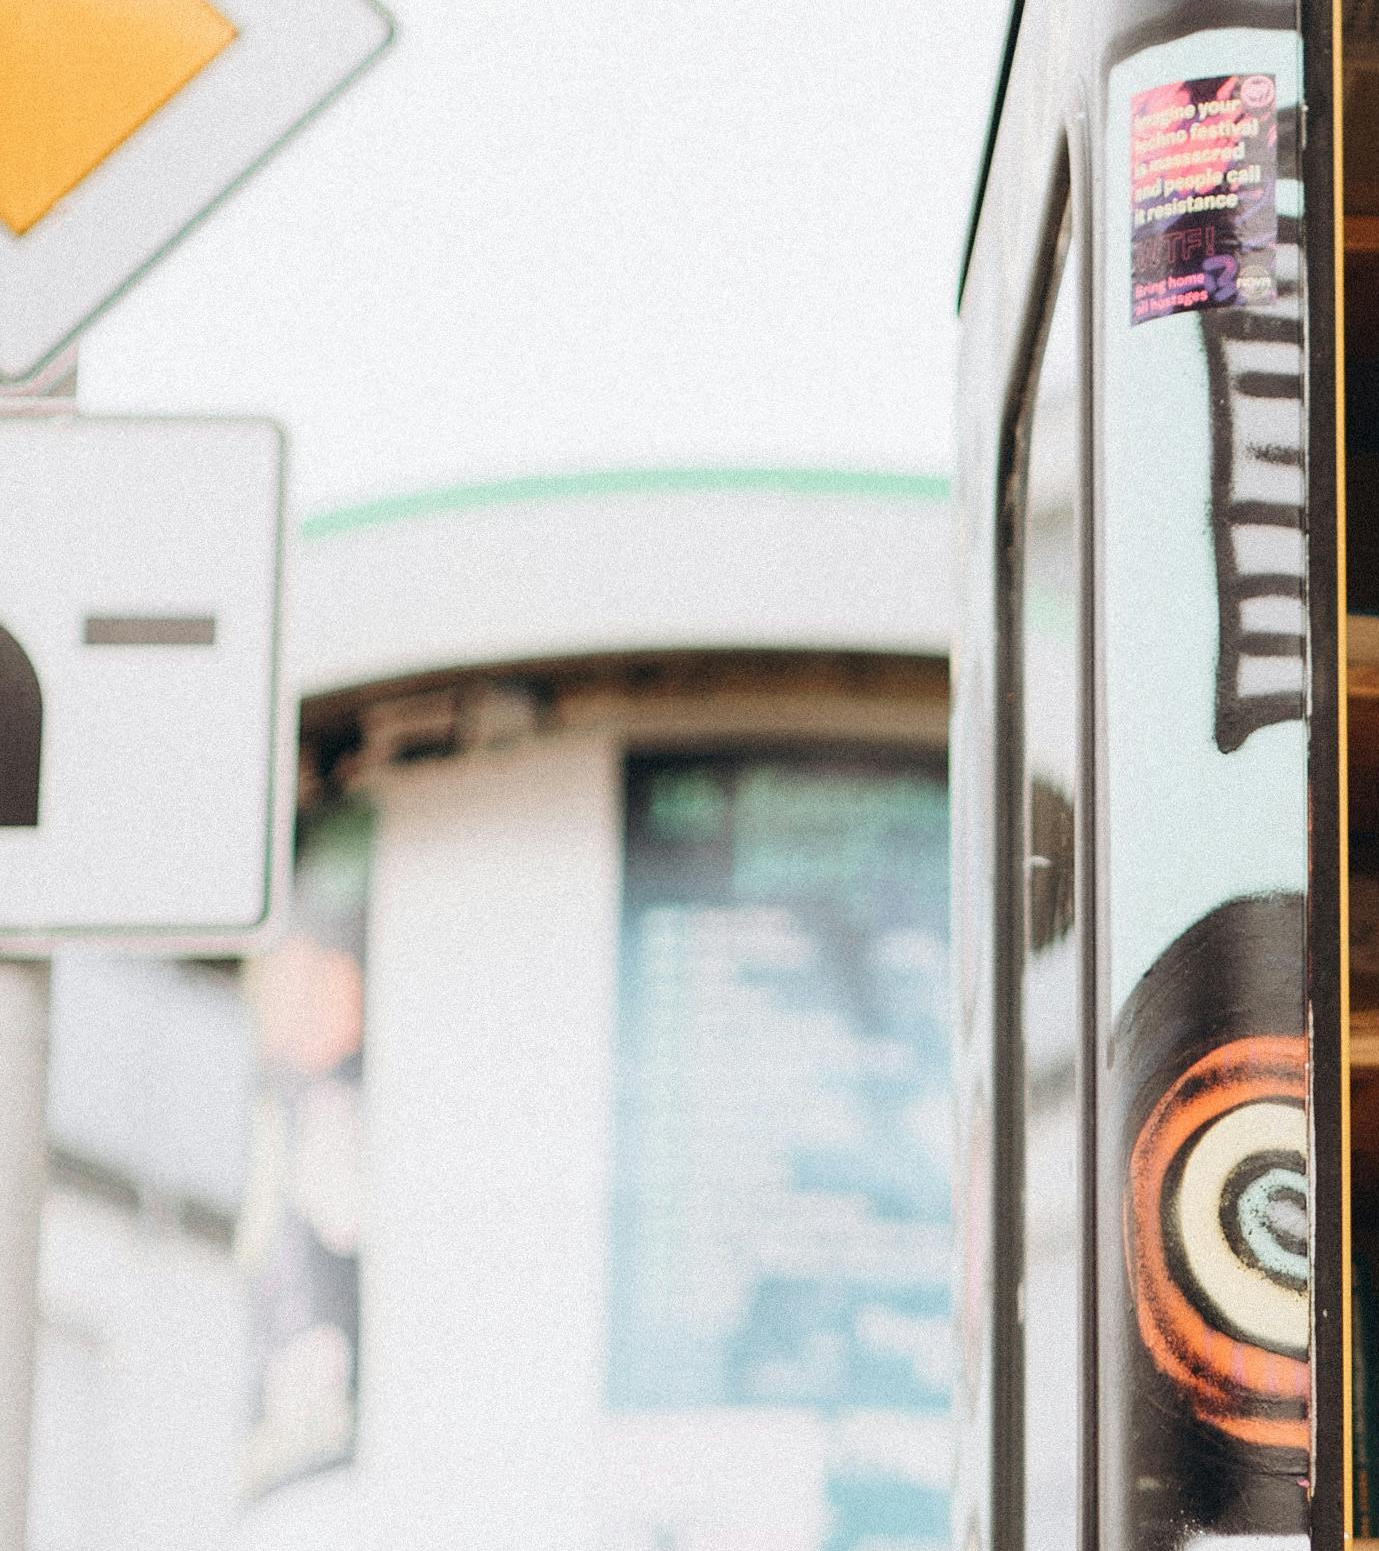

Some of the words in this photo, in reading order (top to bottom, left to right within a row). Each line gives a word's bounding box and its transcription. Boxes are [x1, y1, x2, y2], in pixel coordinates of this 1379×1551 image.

[1198, 99, 1241, 120] your
[1190, 117, 1260, 140] festival
[1148, 141, 1245, 174] massacred
[1136, 177, 1163, 201] and
[1164, 169, 1223, 198] people
[1226, 165, 1261, 184] call
[1147, 193, 1239, 222] resistance
[1168, 272, 1206, 290] home
[1151, 288, 1209, 311] hostages
